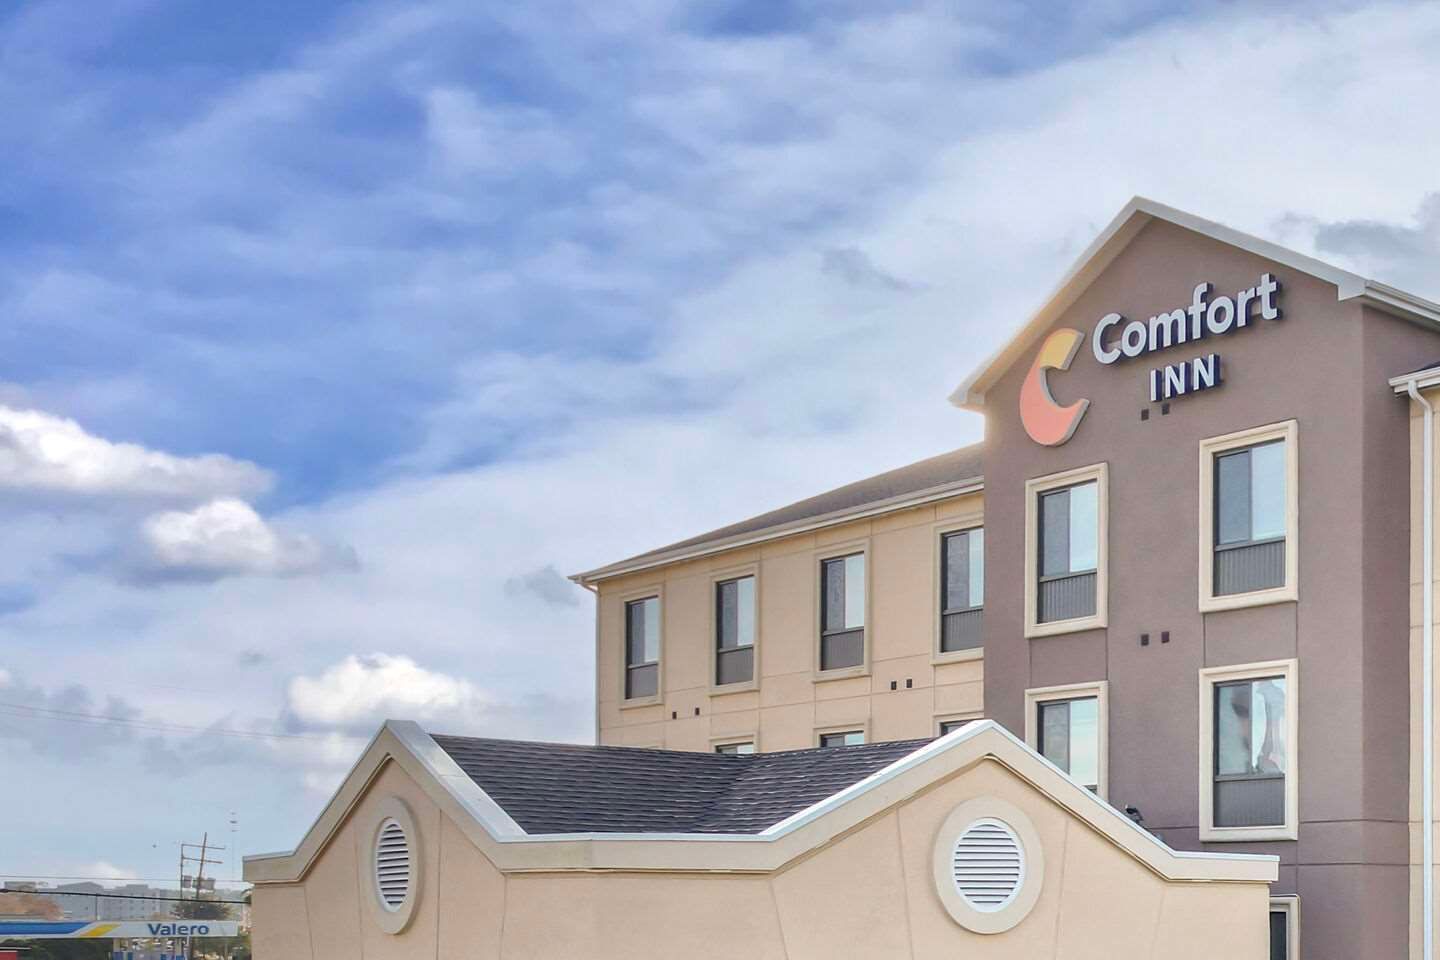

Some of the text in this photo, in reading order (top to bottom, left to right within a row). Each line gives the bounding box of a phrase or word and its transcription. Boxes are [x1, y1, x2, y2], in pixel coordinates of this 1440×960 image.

[1092, 272, 1279, 365] Comfort
[1150, 353, 1217, 402] INN
[147, 922, 210, 936] Valero
